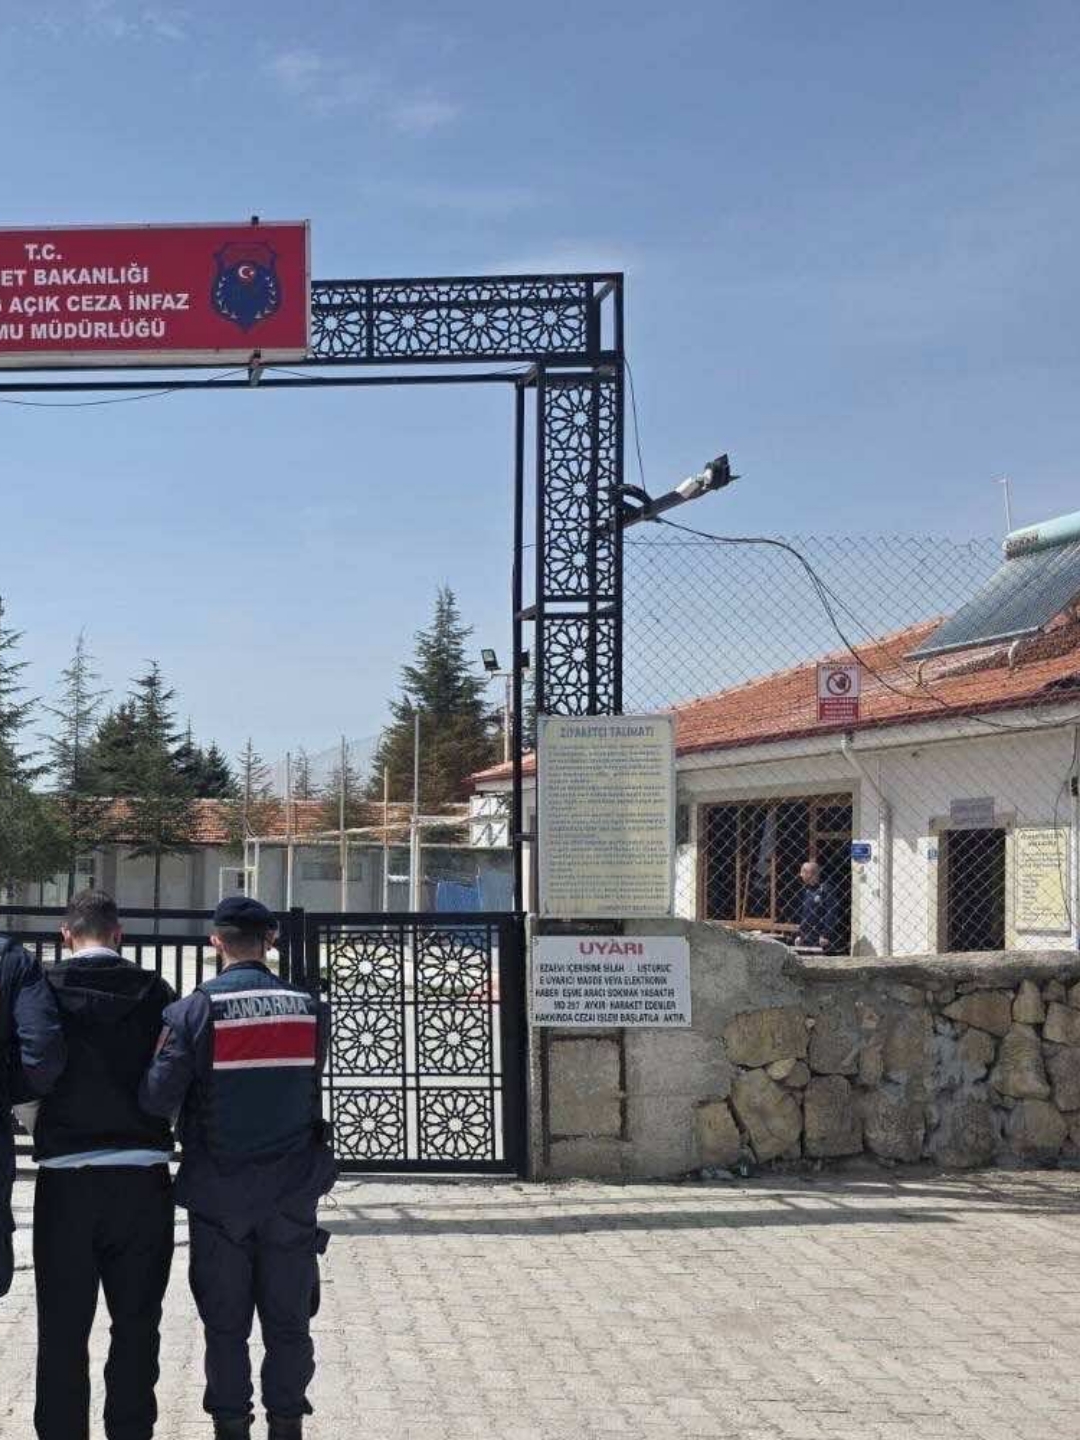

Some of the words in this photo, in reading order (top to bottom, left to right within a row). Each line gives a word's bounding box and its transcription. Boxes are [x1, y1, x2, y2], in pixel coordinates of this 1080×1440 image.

[25, 244, 62, 260] T.C.
[34, 262, 149, 286] BAKANLIĞI
[9, 296, 60, 317] AÇIK
[67, 295, 121, 312] CEZA
[129, 291, 189, 311] İNFAZ
[31, 318, 165, 339] MÜDÜRLÜĞÜ
[579, 942, 644, 955] UYARI
[223, 996, 310, 1019] JANDARMA
